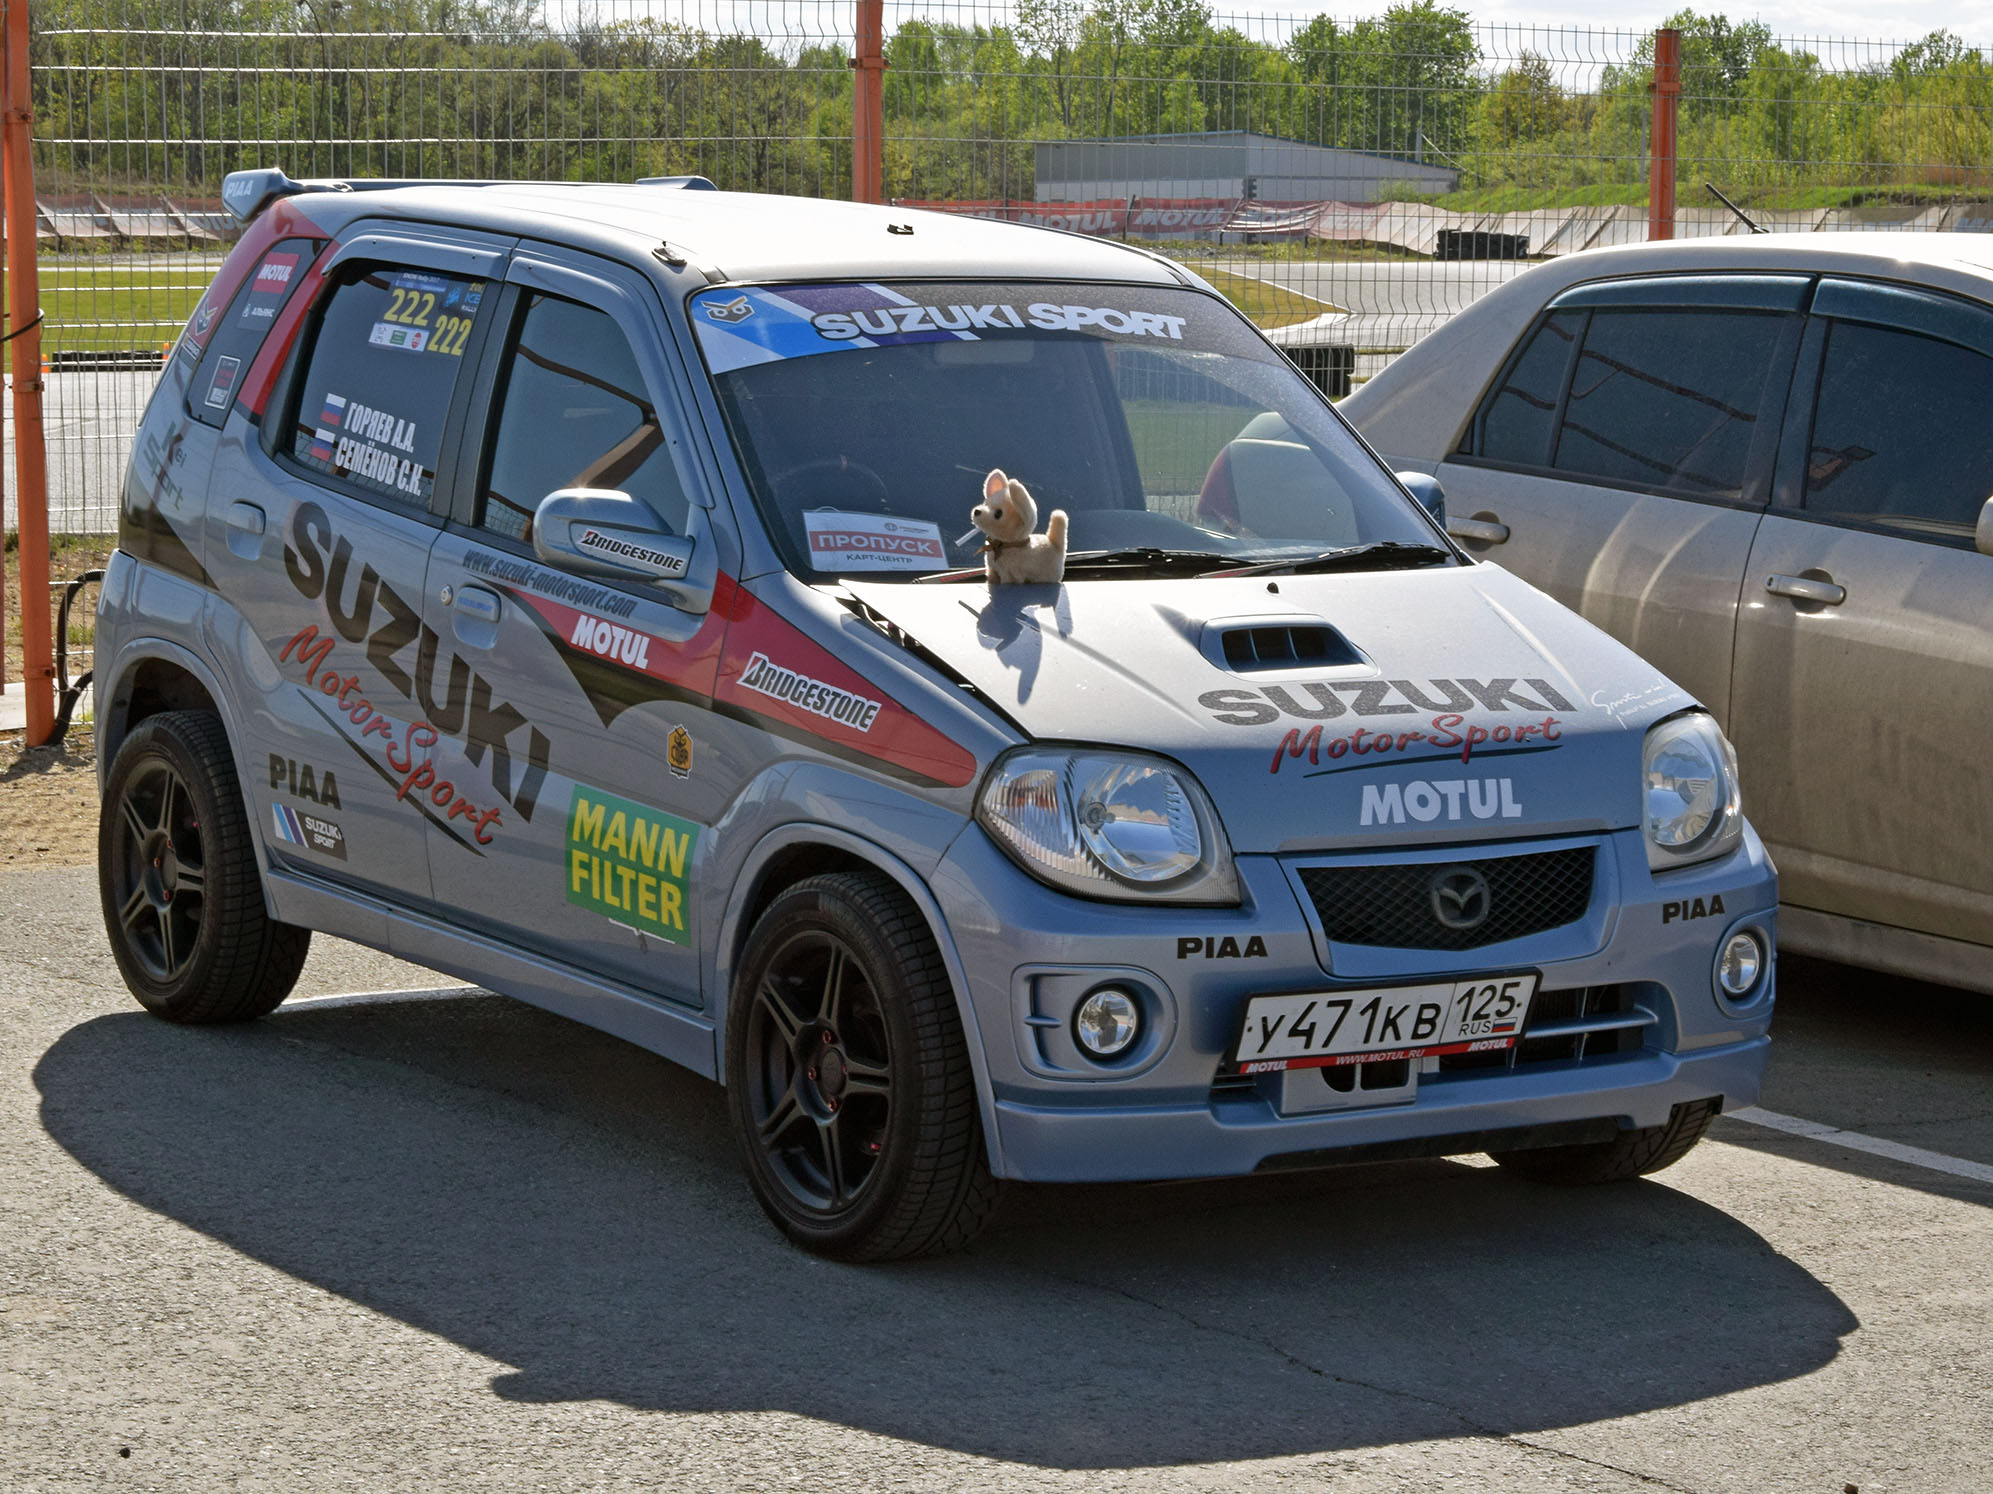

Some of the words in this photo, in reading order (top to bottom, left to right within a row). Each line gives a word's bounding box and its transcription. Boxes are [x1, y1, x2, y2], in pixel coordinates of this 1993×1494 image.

[226, 180, 254, 198] PIAA
[1019, 209, 1119, 232] MOTUL
[1133, 206, 1225, 226] MOTUL
[257, 264, 293, 282] MOTUL
[383, 288, 436, 327] 222
[813, 304, 1027, 339] SUZUKI
[1028, 303, 1186, 340] SPORT
[427, 314, 472, 356] 222
[344, 402, 395, 444] ГОРЯЕВ
[335, 436, 398, 485] СЕМЁНОВ
[581, 530, 684, 571] BRIDGESTONE
[819, 534, 934, 554] ПРОПУСК
[846, 554, 913, 564] КАРТ-ЦЕНТР
[462, 549, 638, 619] www.suzuki-motorsport.com
[571, 614, 651, 669] MOTUL
[284, 502, 551, 824] SUZUKI
[741, 654, 879, 730] BRIDGESTONE
[1198, 678, 1578, 726] SUZUKI
[269, 753, 342, 811] PIAA
[1359, 778, 1522, 826] MOTUL
[305, 817, 342, 840] SUZUKI
[313, 833, 335, 849] SPORT
[572, 798, 690, 878] MANN
[572, 849, 684, 931] FILTER
[1663, 894, 1726, 925] PIAA
[1177, 936, 1268, 960] PIAA
[1456, 981, 1521, 1022] 125
[1458, 1020, 1492, 1036] RUS
[1468, 1038, 1509, 1052] MOTUL
[1246, 1060, 1288, 1074] MOTUL
[1335, 1049, 1426, 1066] WWW.MOTUL.RU
